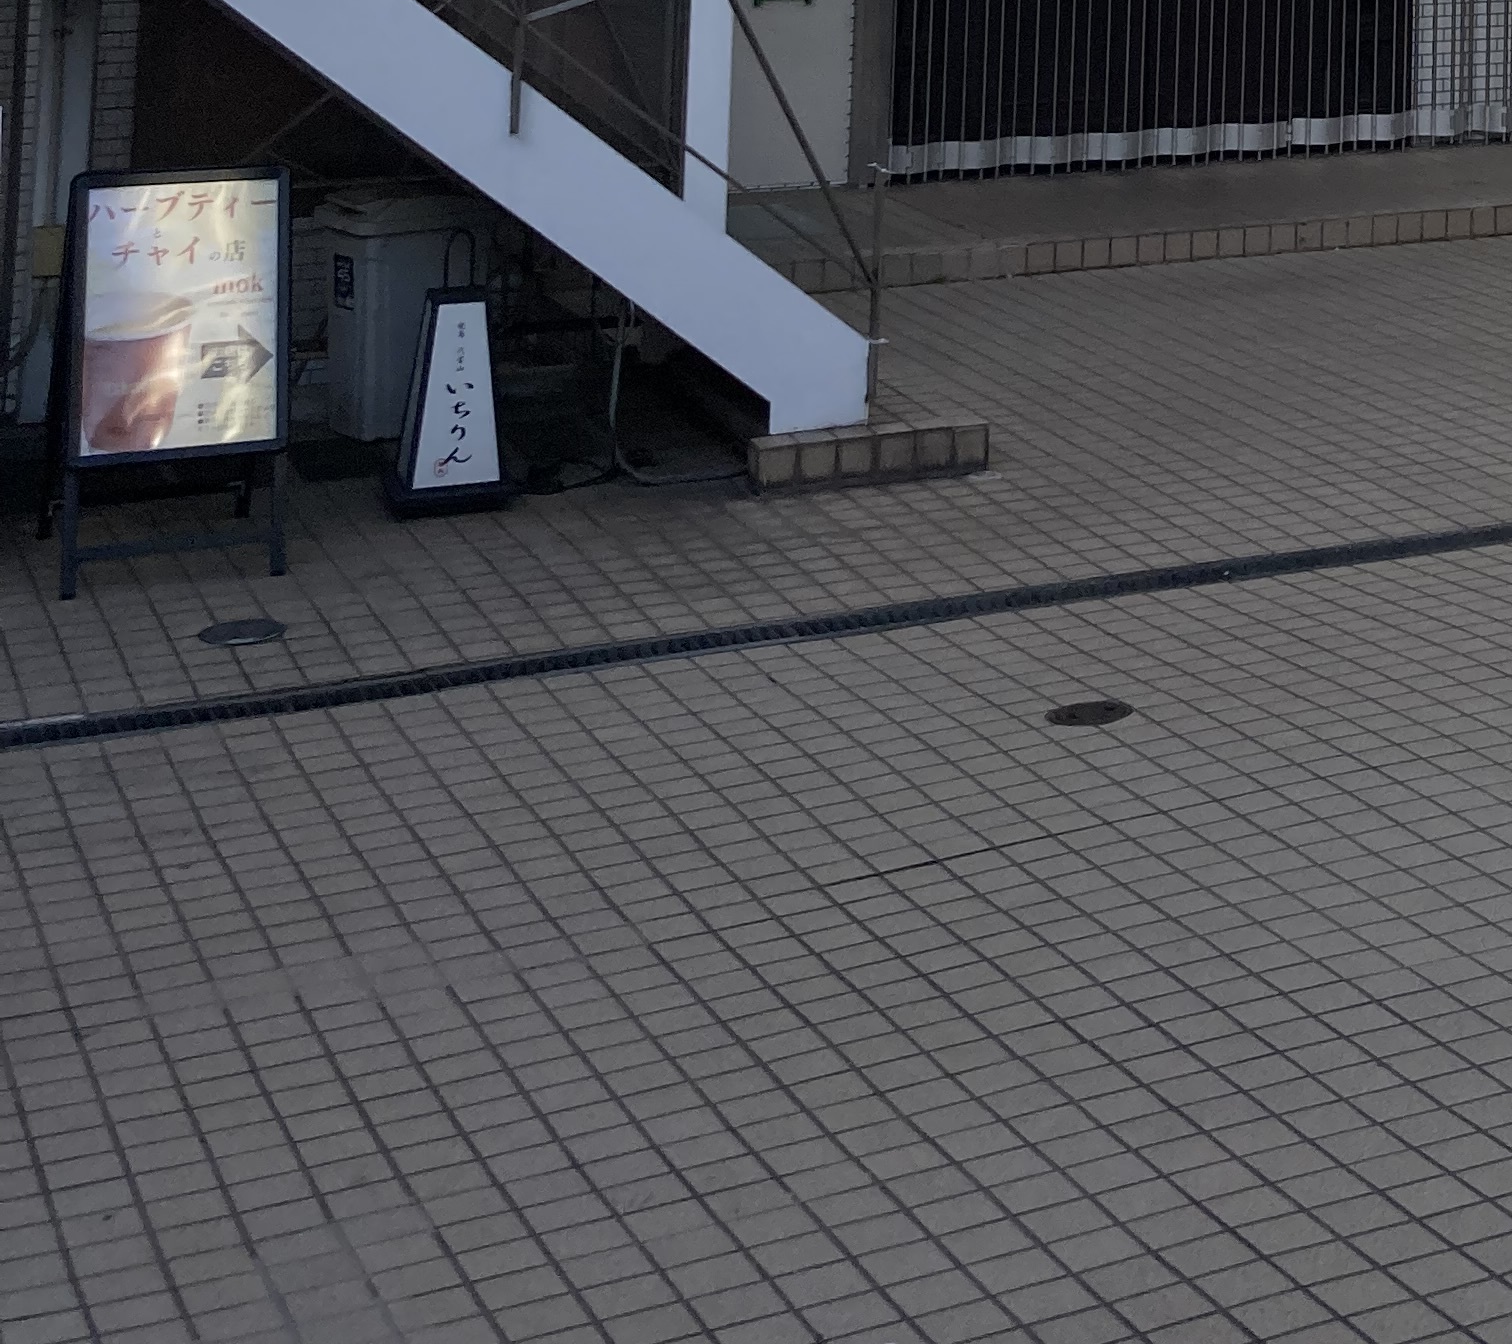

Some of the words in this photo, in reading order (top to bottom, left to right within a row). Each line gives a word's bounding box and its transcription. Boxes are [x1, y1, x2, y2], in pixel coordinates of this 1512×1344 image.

[89, 191, 277, 222] ハーブティー
[441, 382, 475, 467] いちりん
